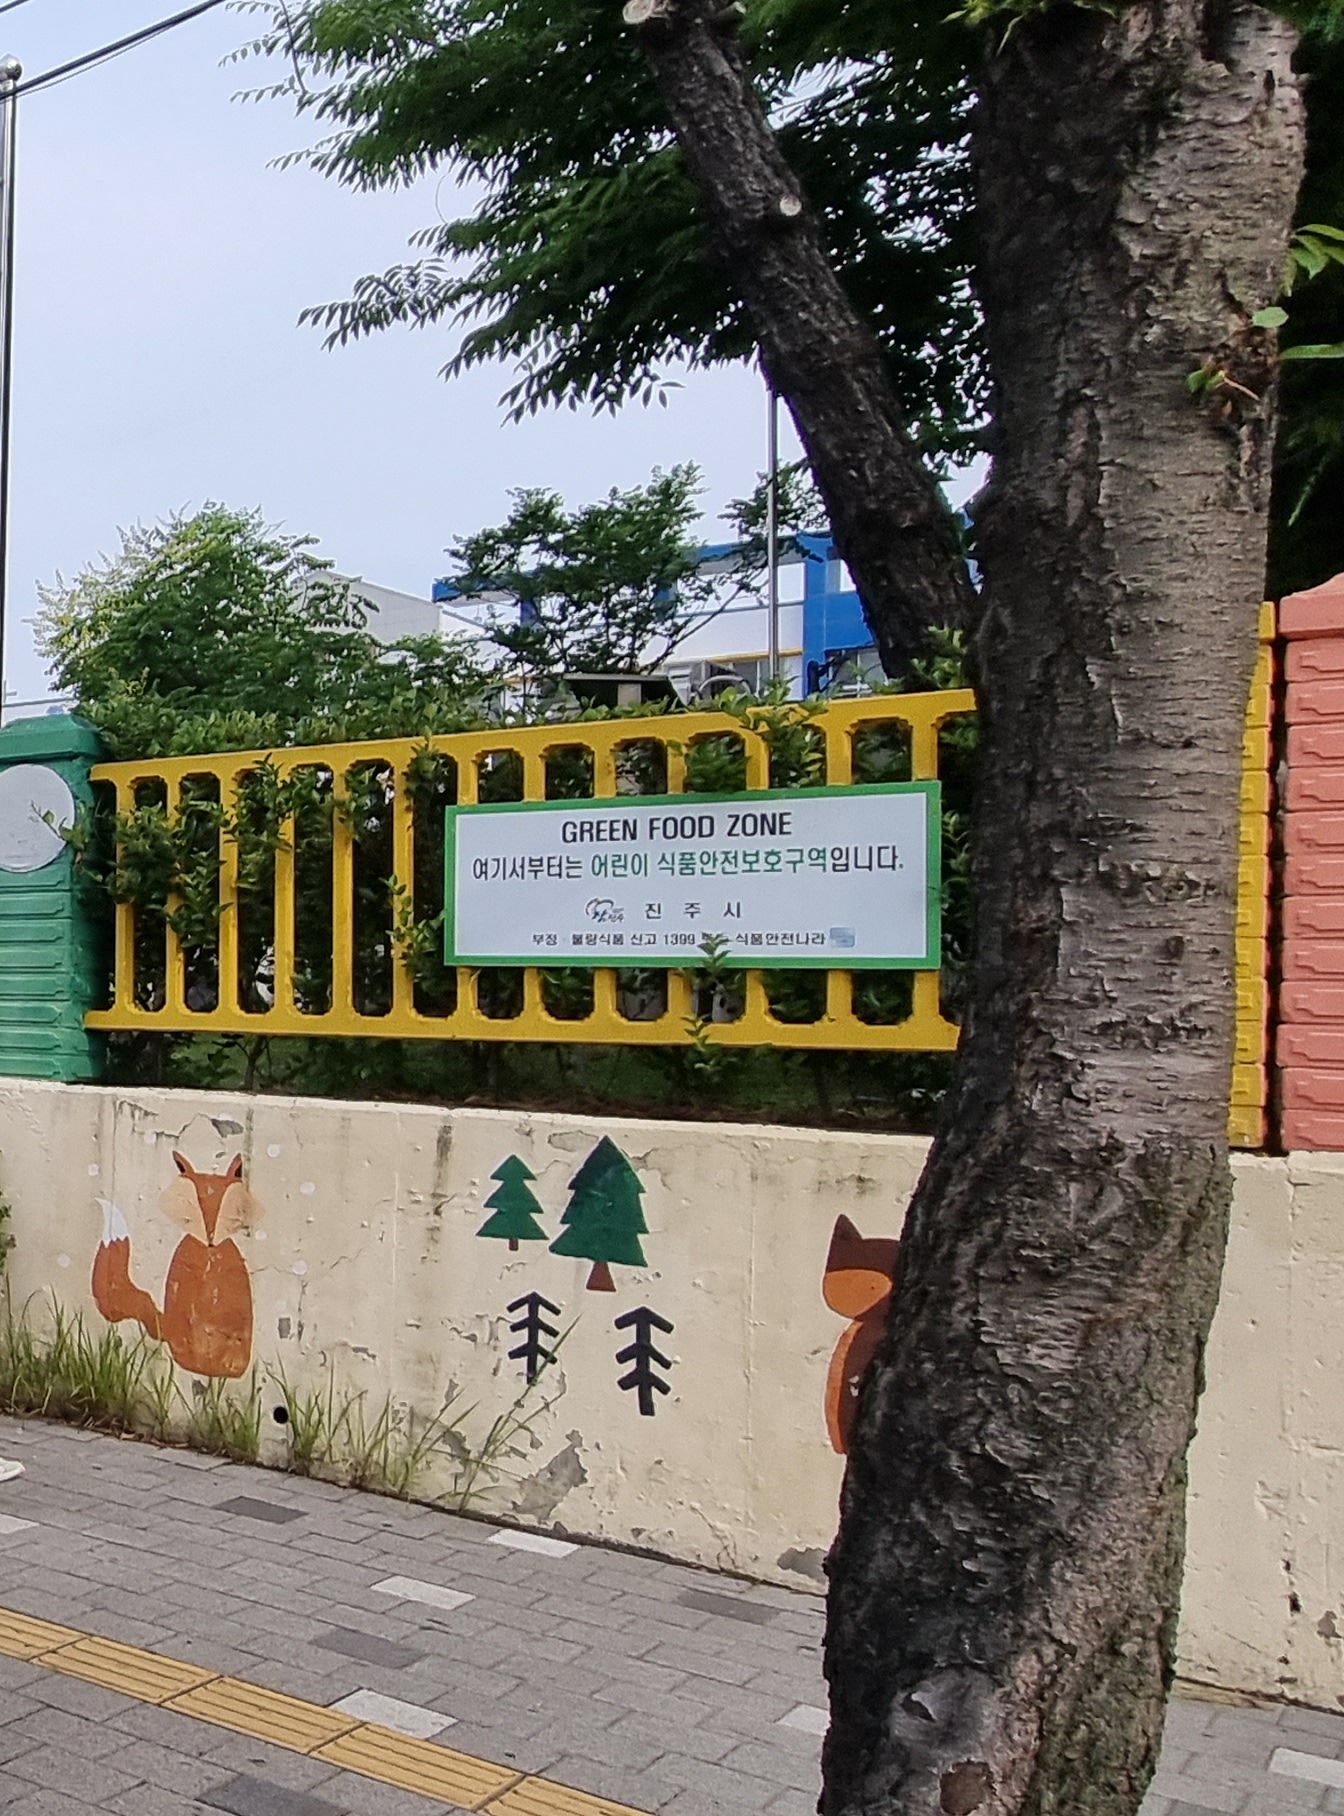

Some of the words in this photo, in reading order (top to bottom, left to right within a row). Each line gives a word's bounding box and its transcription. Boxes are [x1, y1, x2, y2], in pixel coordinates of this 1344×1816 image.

[561, 818, 638, 844] GREEN
[648, 815, 716, 841] FOOD
[727, 811, 793, 837] ZONE
[471, 855, 583, 882] 여기서부터는
[591, 852, 649, 880] 어린이
[656, 844, 906, 879] 식품안전보호구역입니다.
[571, 932, 625, 947] 불량식품
[630, 932, 658, 946] 신고
[735, 931, 827, 947] 식품안전나라
